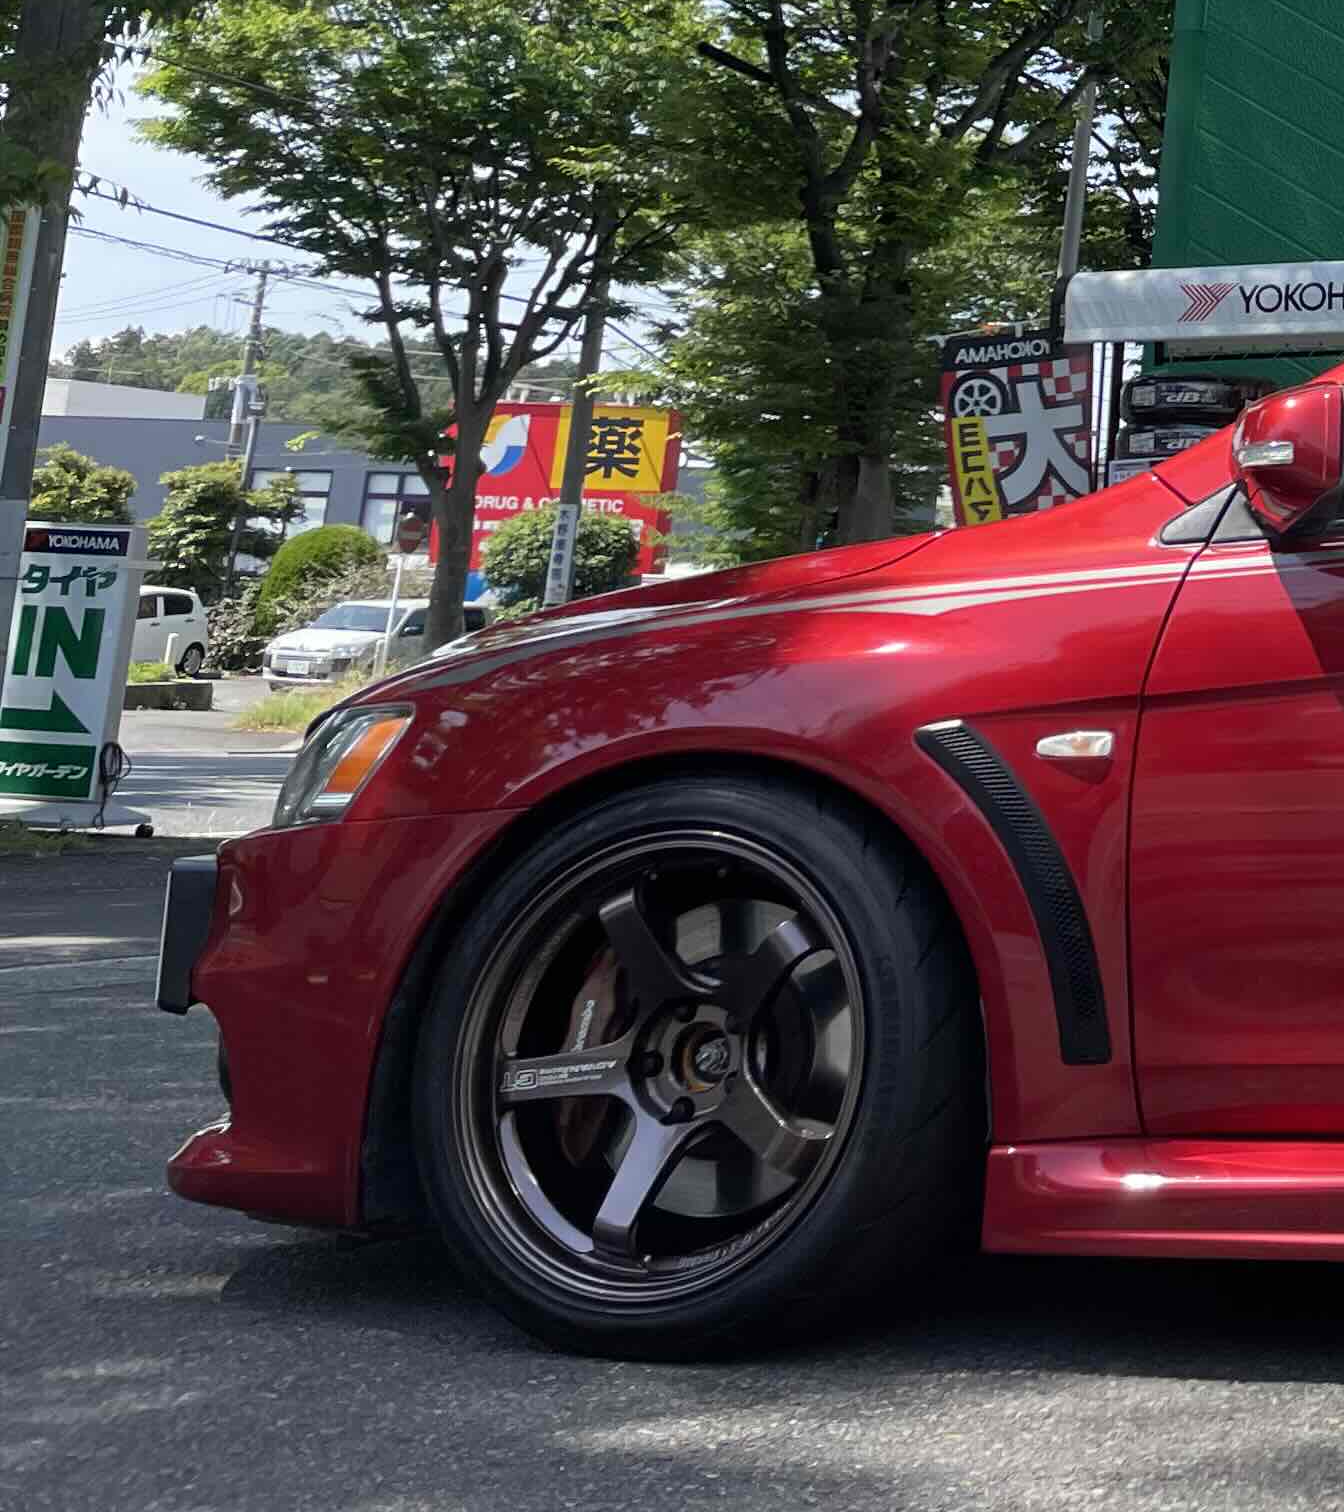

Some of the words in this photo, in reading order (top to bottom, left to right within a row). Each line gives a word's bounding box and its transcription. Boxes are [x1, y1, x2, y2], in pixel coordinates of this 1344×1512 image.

[584, 417, 645, 479] 薬
[47, 533, 120, 551] YOKOHAMA
[21, 563, 119, 597] タイヤ
[11, 604, 106, 680] IN
